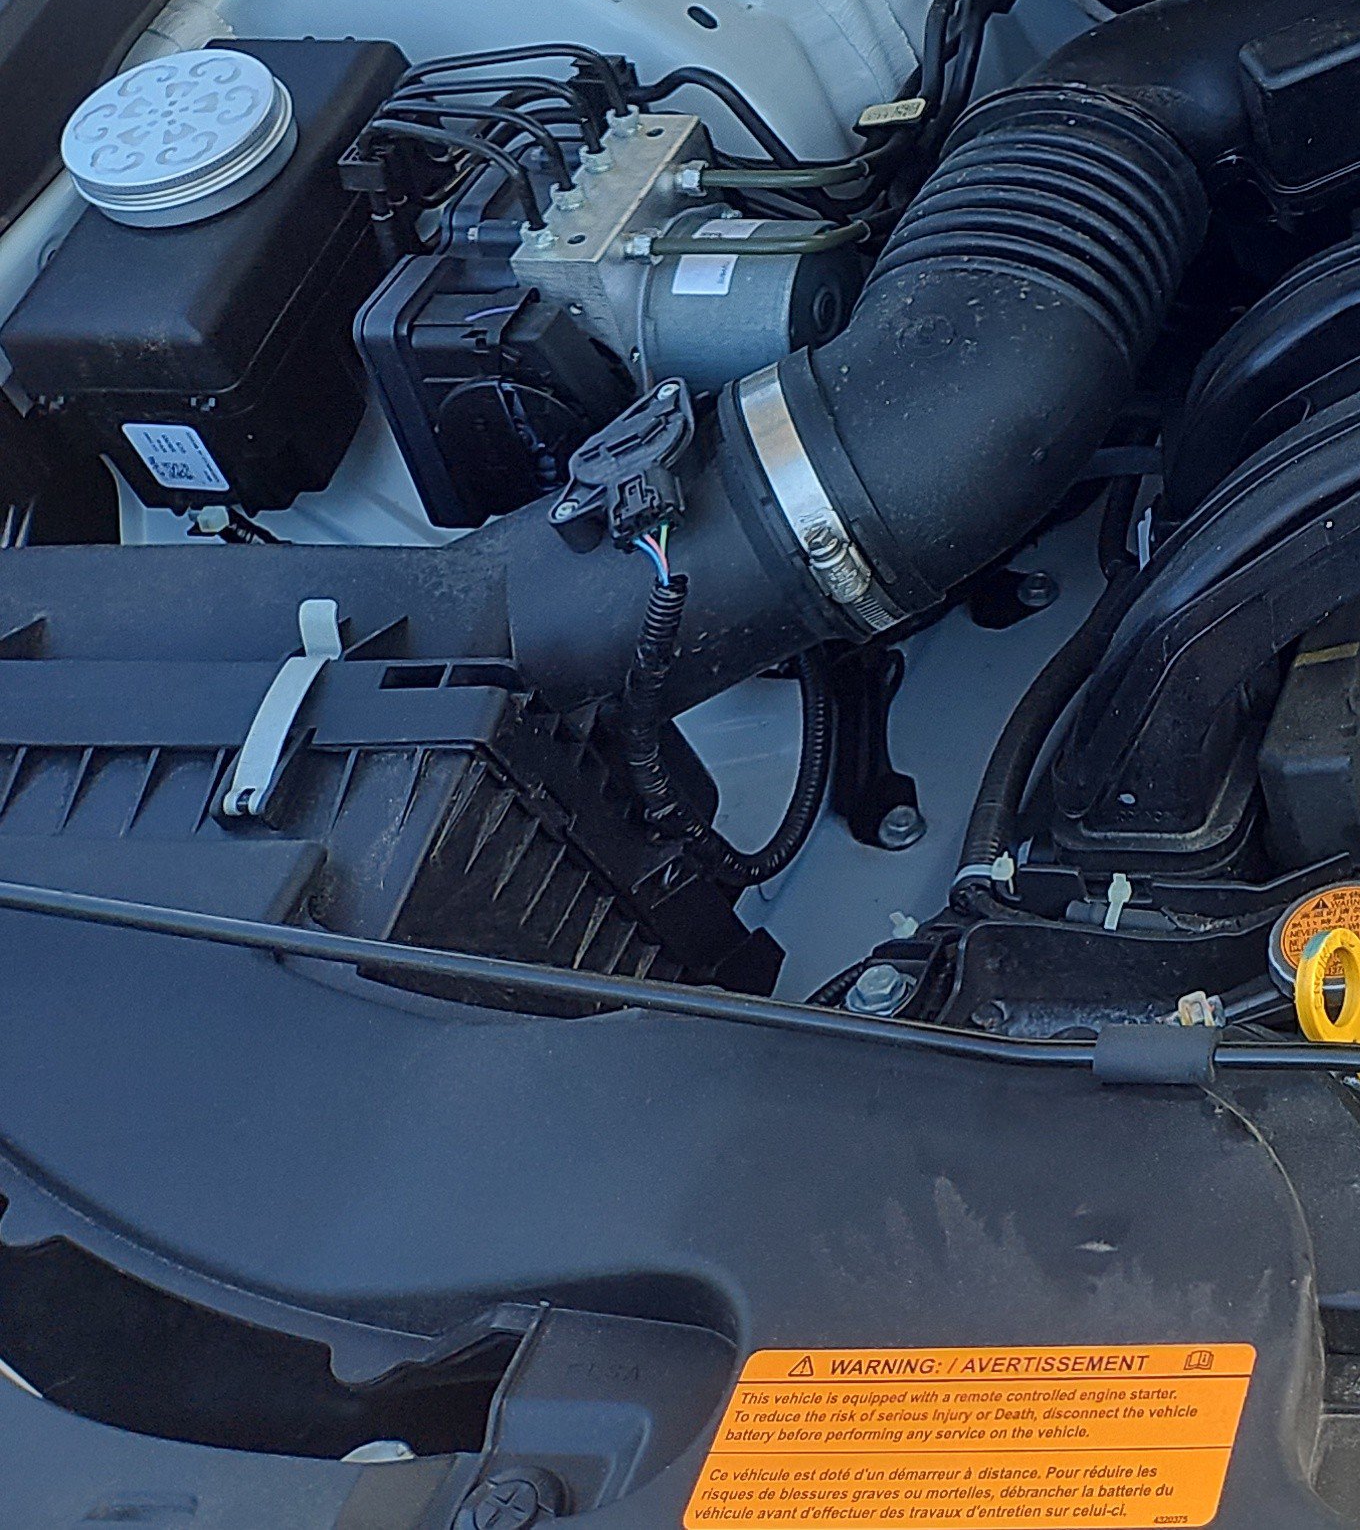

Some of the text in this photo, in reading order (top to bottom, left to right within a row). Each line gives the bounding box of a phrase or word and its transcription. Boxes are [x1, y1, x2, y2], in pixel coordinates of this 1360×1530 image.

[1290, 928, 1319, 938] NEVER
[829, 1355, 1150, 1375] WARNING: / AVERTISSEMENT
[741, 1388, 1178, 1407] This vehicle is equipped with a remote controlled engine starter.
[734, 1410, 750, 1423] To
[753, 1410, 801, 1423] reduce
[804, 1410, 826, 1422] the
[830, 1409, 857, 1422] risk
[860, 1409, 876, 1421] of
[877, 1409, 929, 1421] serious
[976, 1409, 991, 1420] or
[994, 1407, 1038, 1421] Death,
[1043, 1406, 1120, 1420] disconnect
[1123, 1406, 1145, 1419] the
[1149, 1405, 1198, 1418] vehicle
[725, 1425, 1091, 1444] battery before performing any service on the vehicle.
[709, 1464, 1157, 1482] Ce véhicule est doté d'un démarreur à distance. Pour réduire les
[701, 1483, 1174, 1502] risques de blessures graves ou mortelles, débrancher la batterie du
[695, 1503, 1127, 1520] véhicule avant d'effectuer des travaux d'entretien sur celui-ci.
